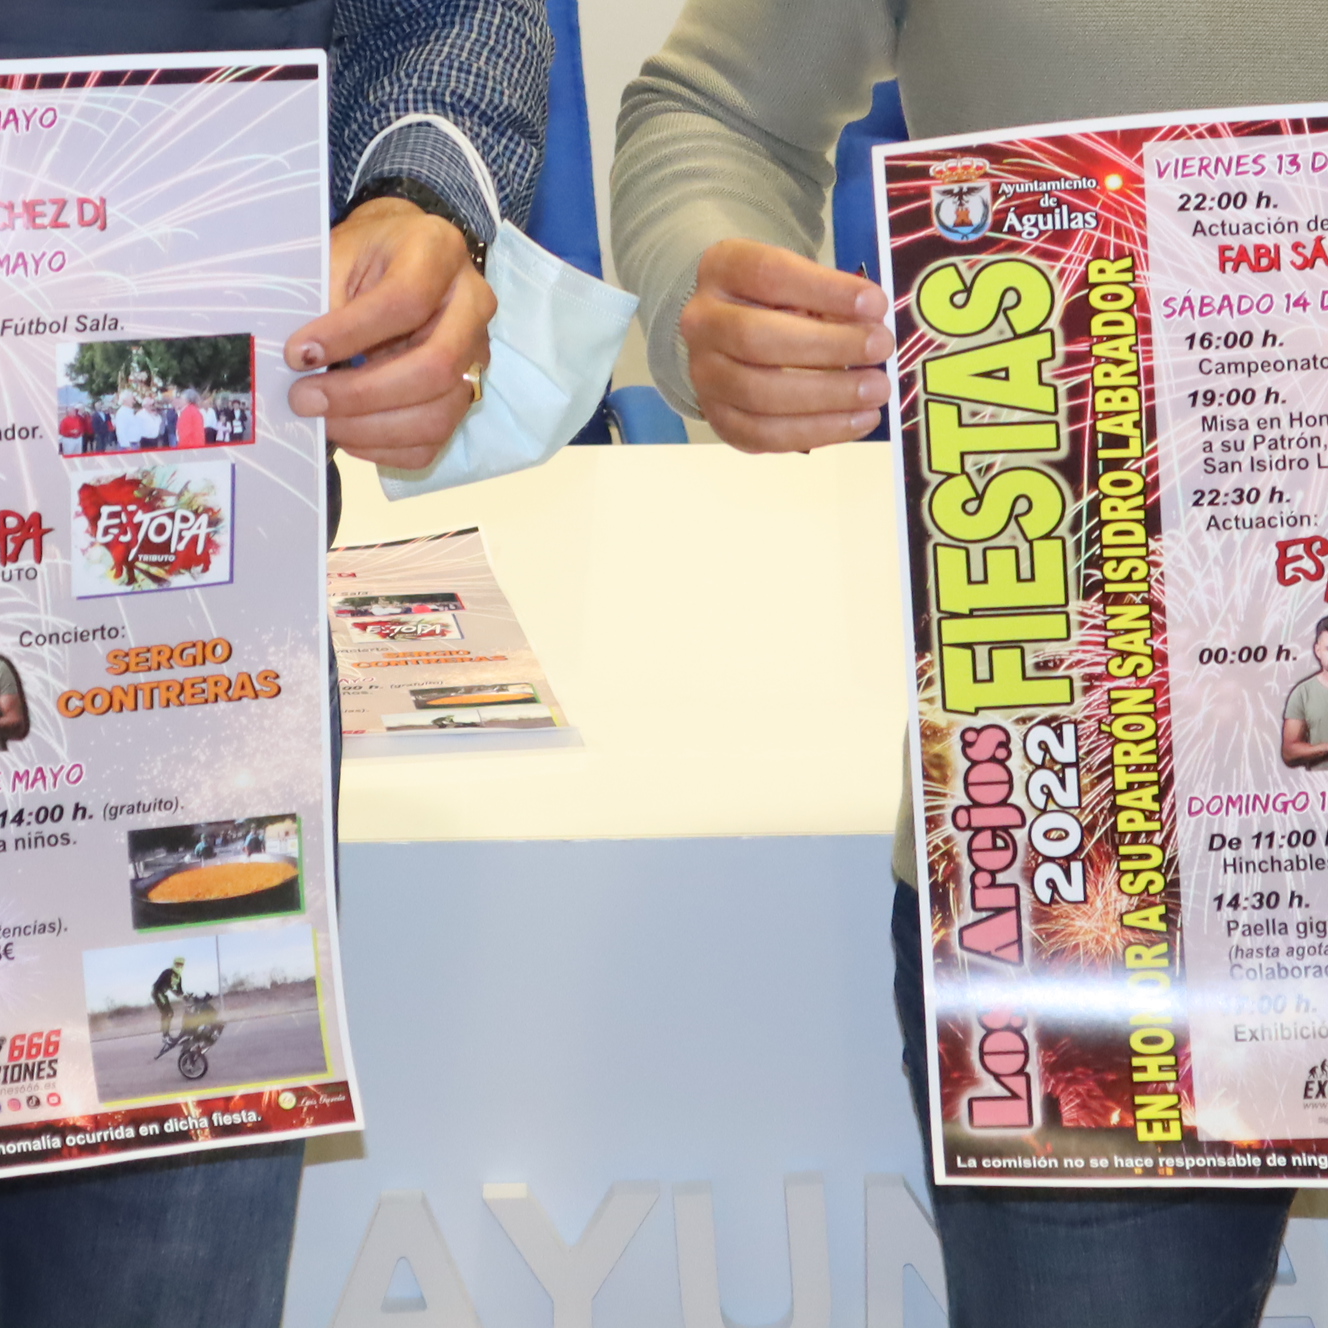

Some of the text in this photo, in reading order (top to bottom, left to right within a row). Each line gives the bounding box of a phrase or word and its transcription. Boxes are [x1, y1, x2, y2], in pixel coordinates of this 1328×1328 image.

[1155, 154, 1267, 179] VIERNES
[1276, 153, 1301, 175] 13
[998, 177, 1097, 197] Ayuntamiento
[1040, 194, 1057, 208] de
[1177, 192, 1278, 212] 22:00 h.
[1003, 208, 1098, 239] Águilas
[1192, 216, 1299, 237] Actuación
[1219, 243, 1281, 273] FABI
[1162, 290, 1273, 320] SÁBADO
[1284, 290, 1311, 314] 14
[1185, 330, 1284, 350] 16:00 h.
[1088, 254, 1146, 461] LABRADOR
[1187, 387, 1287, 408] 19:00 h.
[1201, 414, 1250, 433] Misa
[1256, 415, 1281, 430] en
[1202, 431, 1328, 453] a su Patrón,
[1204, 456, 1243, 474] San
[1251, 453, 1309, 472] Isidro
[916, 257, 1074, 715] FIESTAS
[1192, 487, 1291, 507] 22:30 h.
[96, 504, 217, 561] ESTOPA
[1097, 468, 1151, 596] ISIDRO
[1206, 511, 1319, 531] Actuación:
[138, 554, 175, 563] TRIBUTO
[19, 623, 126, 648] Concierto:
[1103, 603, 1156, 679] SAN
[105, 637, 231, 676] SERGIO
[352, 654, 508, 668] CONTRERAS
[382, 649, 470, 659] SERGIO
[1198, 645, 1297, 665] 00:00 h.
[57, 670, 281, 719] CONTRERAS
[1098, 686, 1160, 836] PATRÓN
[12, 764, 84, 793] MAYO
[1023, 722, 1086, 905] 2022
[1187, 790, 1310, 818] DOMINGO
[14, 828, 77, 851] niños.
[952, 723, 1026, 968] Arejos
[1208, 833, 1242, 852] De
[1251, 829, 1317, 850] 11:00
[1119, 843, 1166, 896] SU
[1213, 891, 1310, 912] 14:30 h.
[1123, 900, 1170, 935] A
[1227, 917, 1288, 938] Paella
[1229, 941, 1280, 961] (hasta
[8, 1029, 62, 1063] 666
[1135, 1090, 1183, 1143] EN
[957, 1156, 976, 1168] La
[982, 1155, 1058, 1169] comisión
[1063, 1156, 1084, 1168] no
[1089, 1156, 1109, 1168] se
[1114, 1155, 1153, 1168] hace
[1159, 1154, 1261, 1170] responsable
[1267, 1153, 1287, 1167] de
